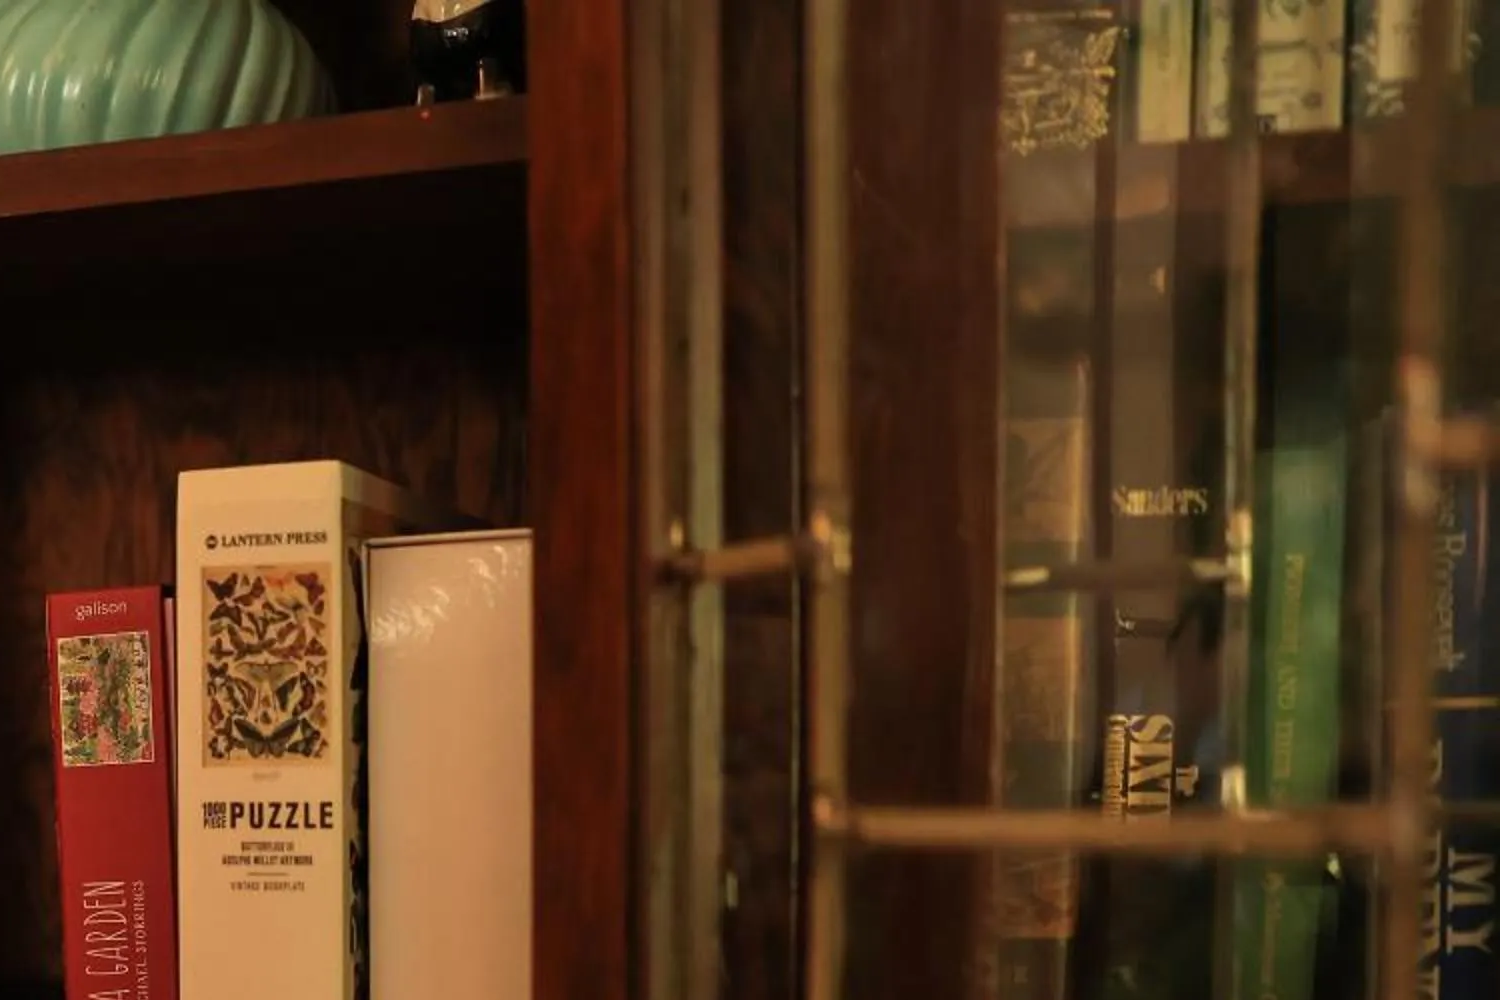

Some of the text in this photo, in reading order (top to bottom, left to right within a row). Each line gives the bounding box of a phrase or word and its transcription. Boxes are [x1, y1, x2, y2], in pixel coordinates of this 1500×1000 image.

[1111, 486, 1208, 516] Sanders
[221, 530, 328, 548] LANTERN PRESS
[74, 600, 127, 621] galison
[1127, 713, 1174, 822] SIXT
[229, 800, 334, 830] PUZZLE
[131, 879, 148, 954] STORRINGS
[1447, 847, 1496, 953] MY
[83, 880, 129, 976] GARDEN
